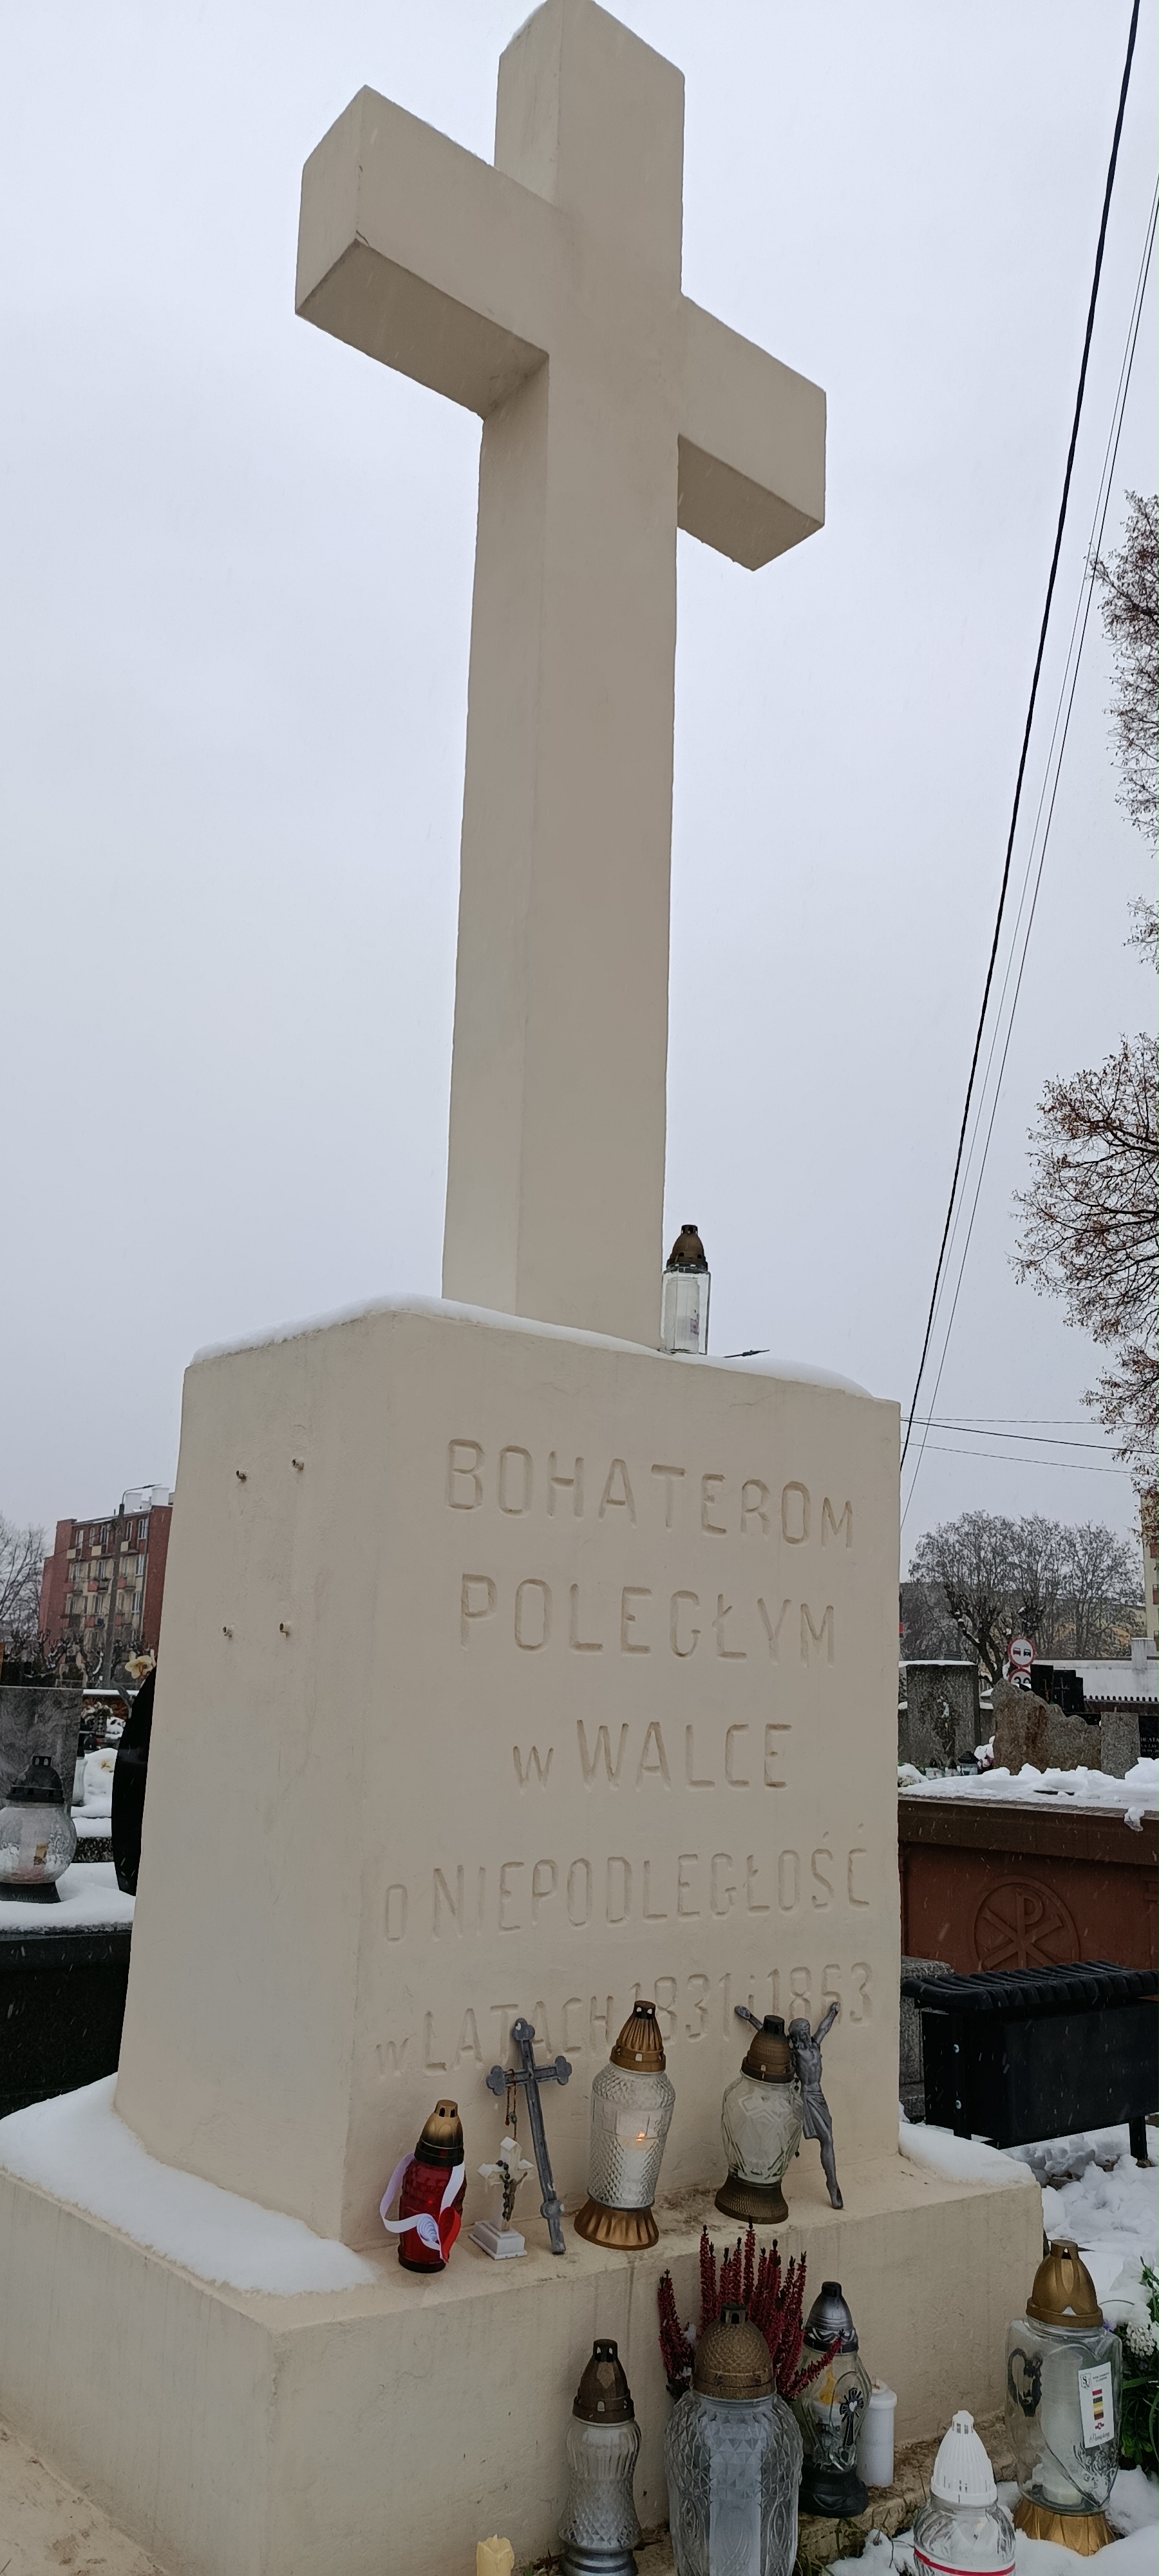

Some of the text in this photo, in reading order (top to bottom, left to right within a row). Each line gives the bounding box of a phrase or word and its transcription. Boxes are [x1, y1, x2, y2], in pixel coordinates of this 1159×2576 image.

[446, 1437, 854, 1549] BOHATEROM
[459, 1572, 836, 1669] POLEGŁYM
[576, 1719, 793, 1793] WALCE
[431, 1823, 871, 1942] NIEPODLEGŁOŚĆ
[422, 1994, 615, 2075] LATACH
[629, 1973, 733, 2047] 831
[766, 1961, 874, 2027] 1863
